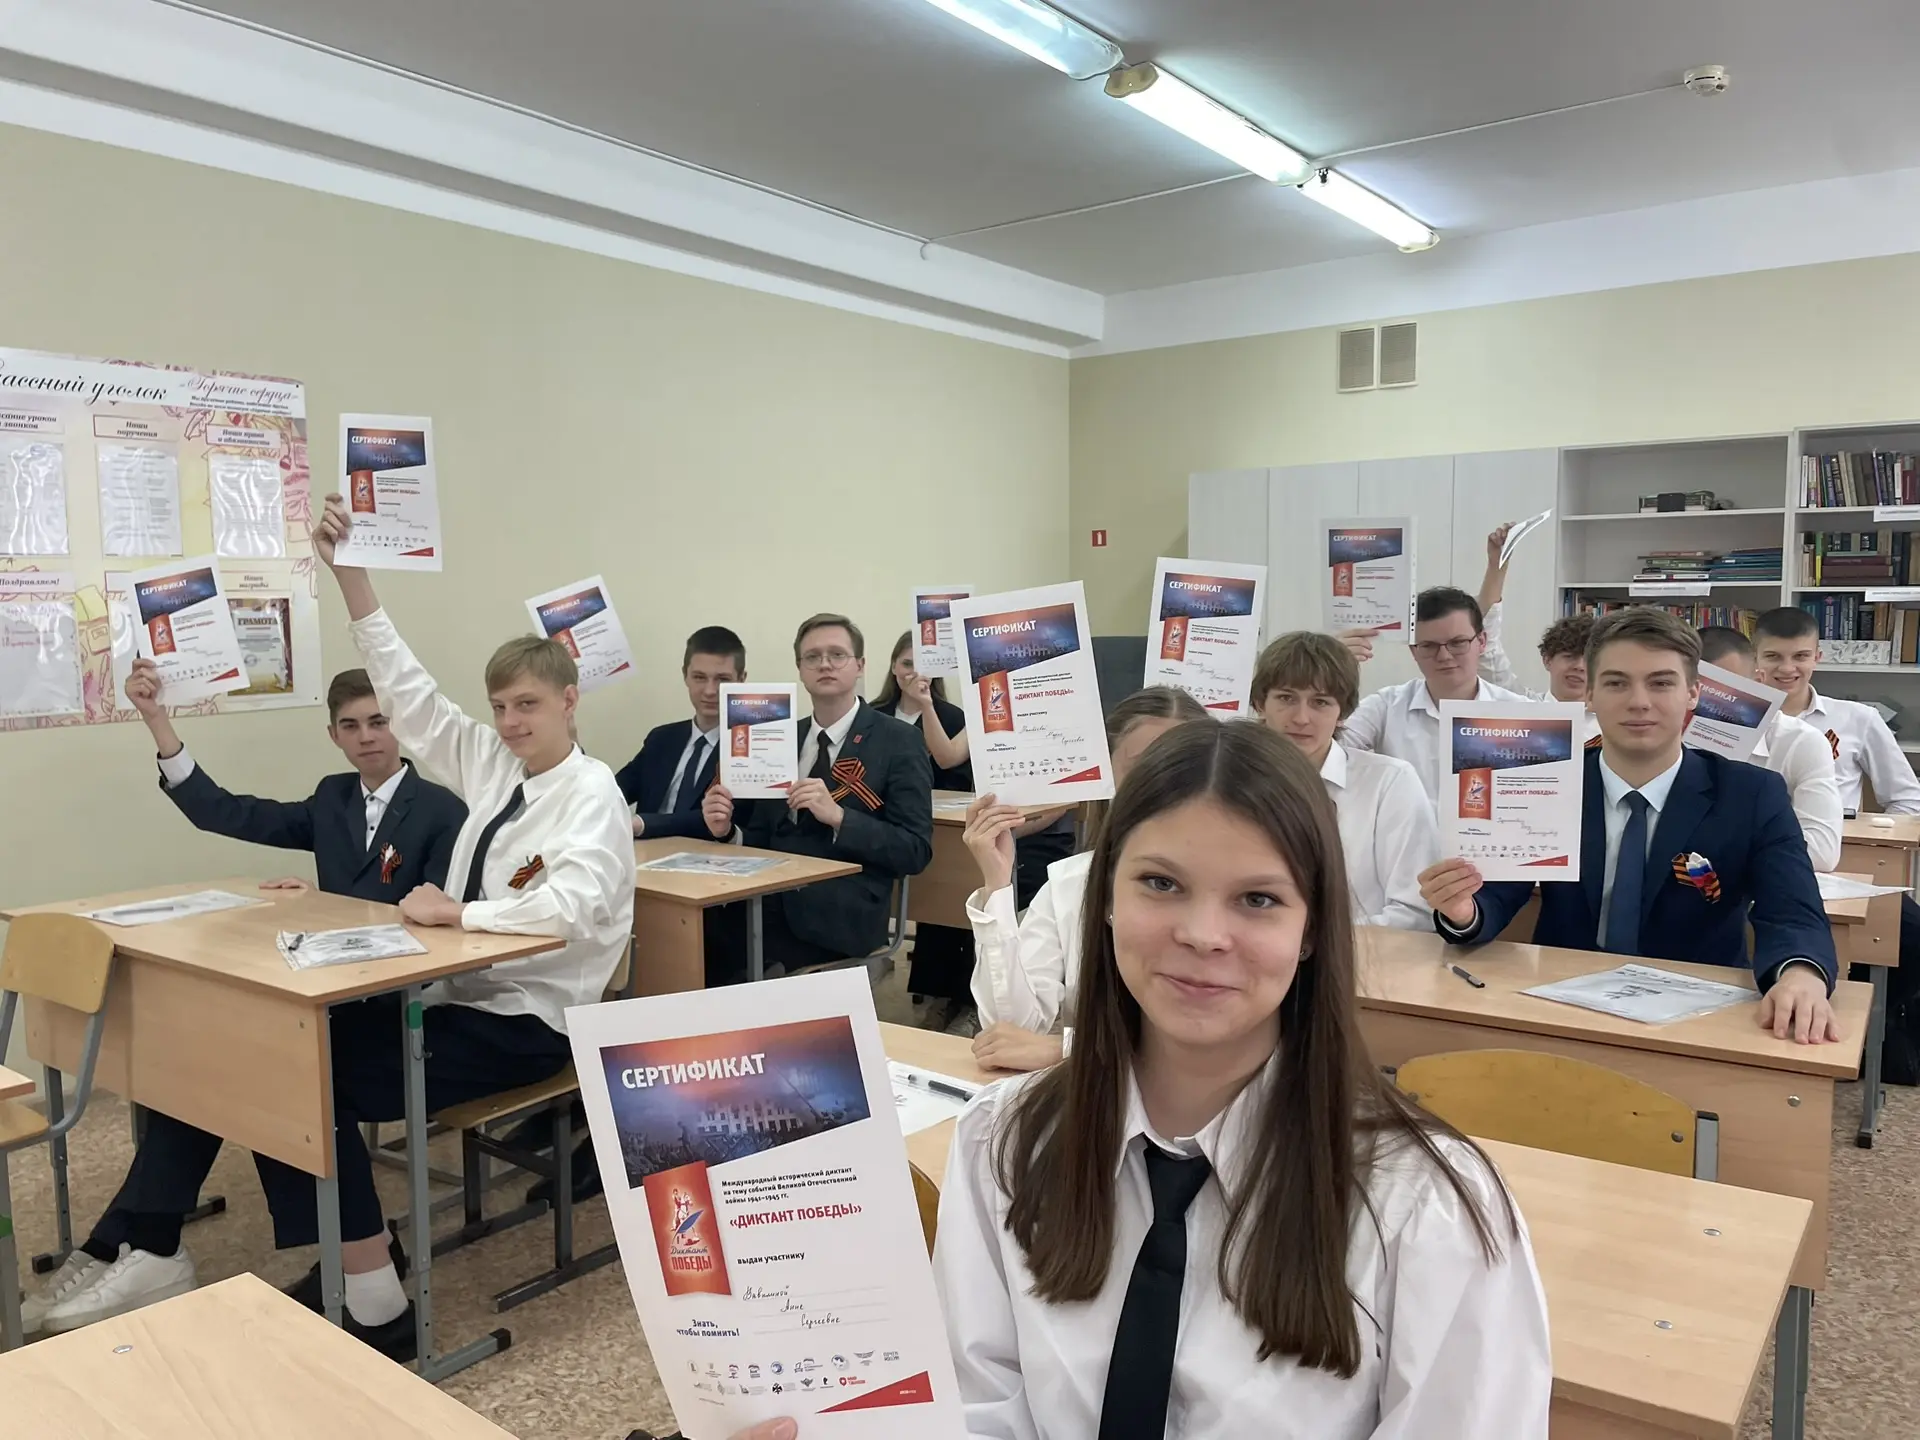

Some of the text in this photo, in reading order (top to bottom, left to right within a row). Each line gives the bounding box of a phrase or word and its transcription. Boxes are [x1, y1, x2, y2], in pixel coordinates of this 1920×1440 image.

[0, 373, 85, 393] ассный
[84, 382, 167, 406] уголок
[351, 435, 396, 446] СЕРТИФИКАТ
[141, 580, 187, 596] СЕРТИФИКАТ
[1169, 581, 1222, 593] СЕРТИФИКАТ
[237, 617, 278, 626] ГРАМОТА
[972, 619, 1037, 638] СЕРТИФИКАТ
[1699, 683, 1737, 703] ТИФИКАТ
[1460, 727, 1531, 738] СЕРТИФИКАТ
[621, 1053, 765, 1089] СЕРТИФИКАТ
[722, 1167, 852, 1187] Международный исторический диктант
[732, 1188, 747, 1196] тему
[748, 1184, 776, 1194] событий
[777, 1180, 806, 1190] Великой
[807, 1175, 857, 1187] Отечественной
[725, 1196, 746, 1204] войны
[729, 1203, 862, 1229] «ДИКТАНТ ПОБЕДЫ»
[670, 1246, 708, 1254] Диктант
[671, 1255, 712, 1272] ПОБЕДЫ
[737, 1252, 805, 1264] выдан участнику
[692, 1319, 718, 1328] Знать,
[701, 1329, 740, 1337] помнить!
